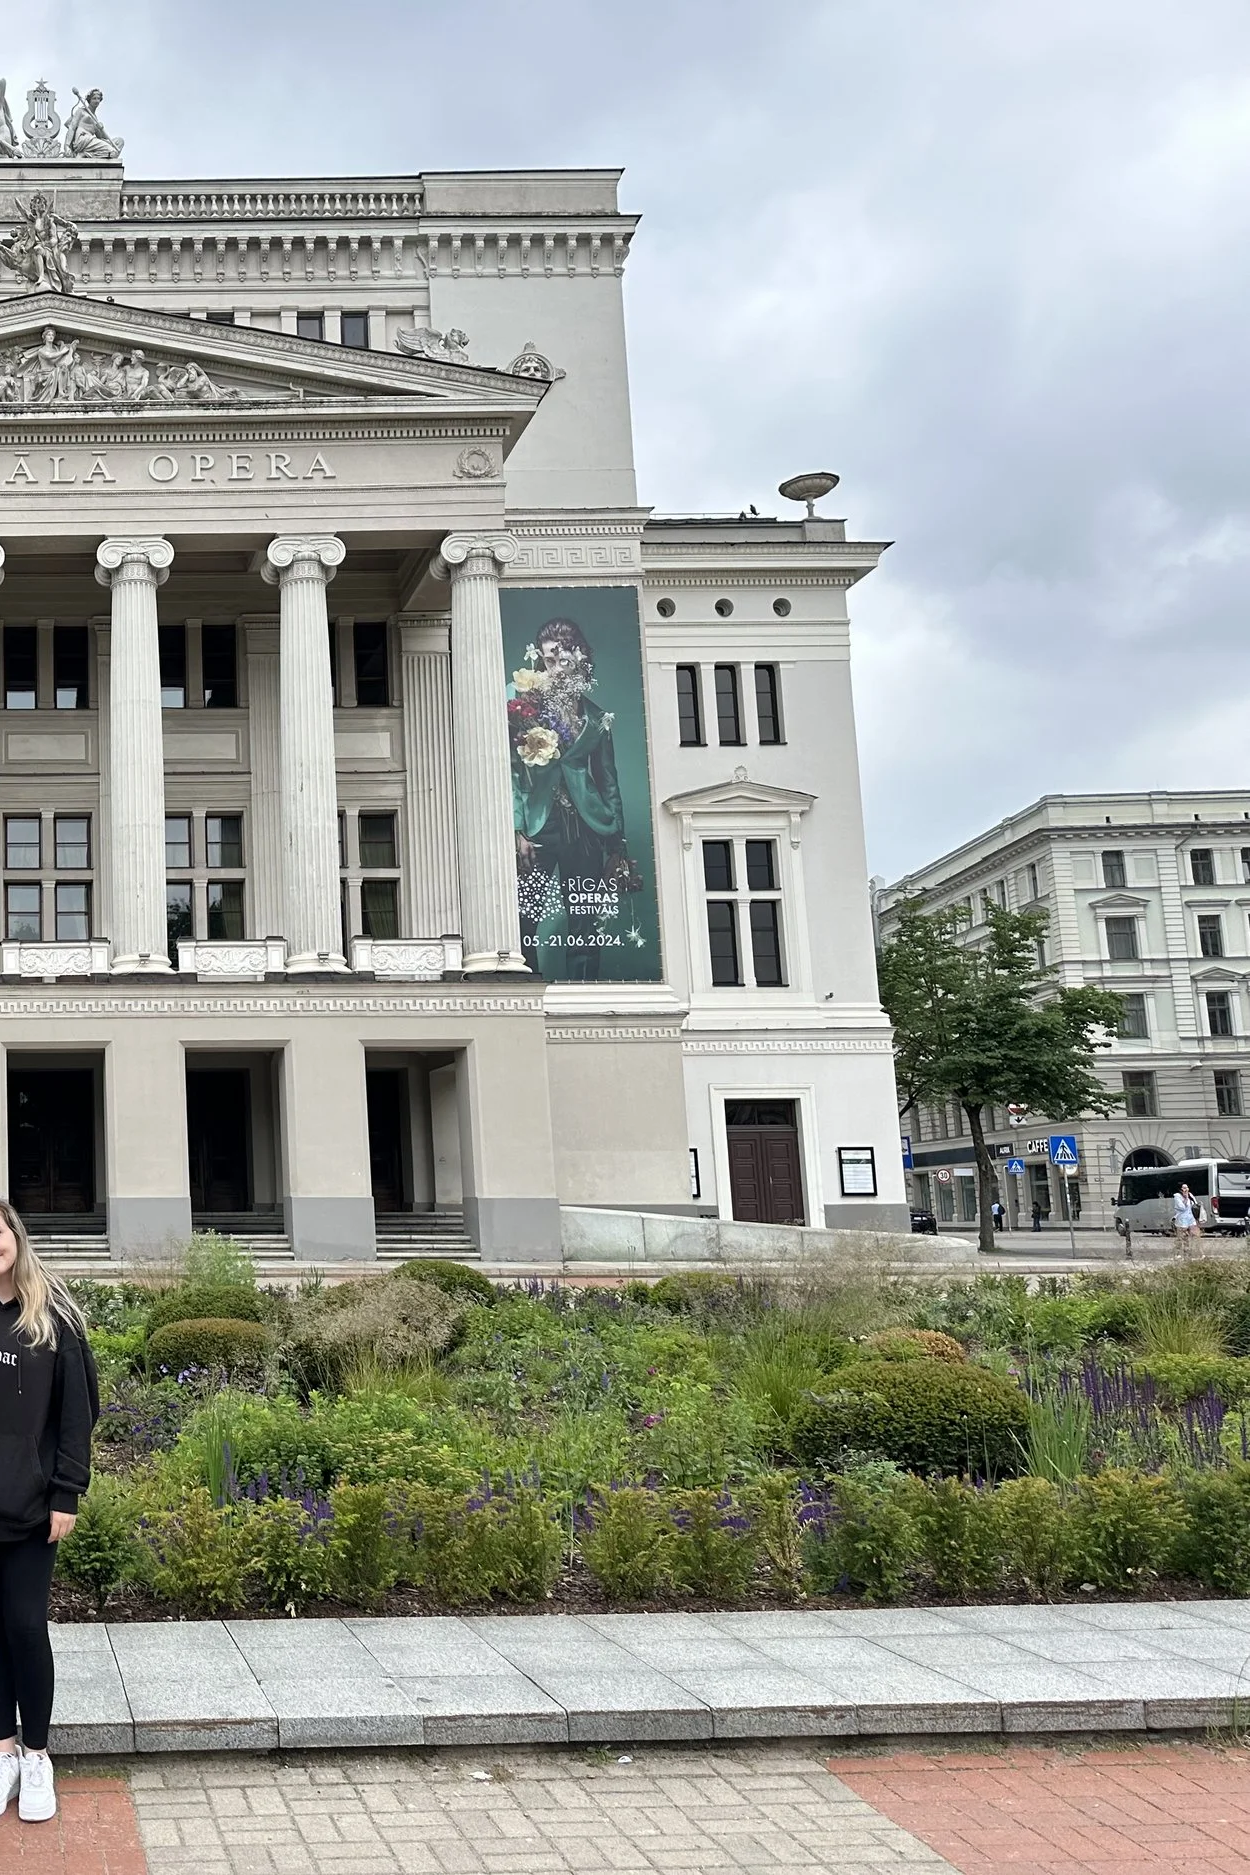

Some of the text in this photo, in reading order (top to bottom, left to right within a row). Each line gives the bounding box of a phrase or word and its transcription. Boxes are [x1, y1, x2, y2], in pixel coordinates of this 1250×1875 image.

[147, 451, 338, 483] OPERA
[568, 876, 618, 892] RĪGAS
[568, 893, 619, 903] OPERAS
[569, 904, 619, 915] FESTIVĀLS
[522, 934, 625, 947] 05.-21.06.2024.
[940, 1171, 949, 1180] 30
